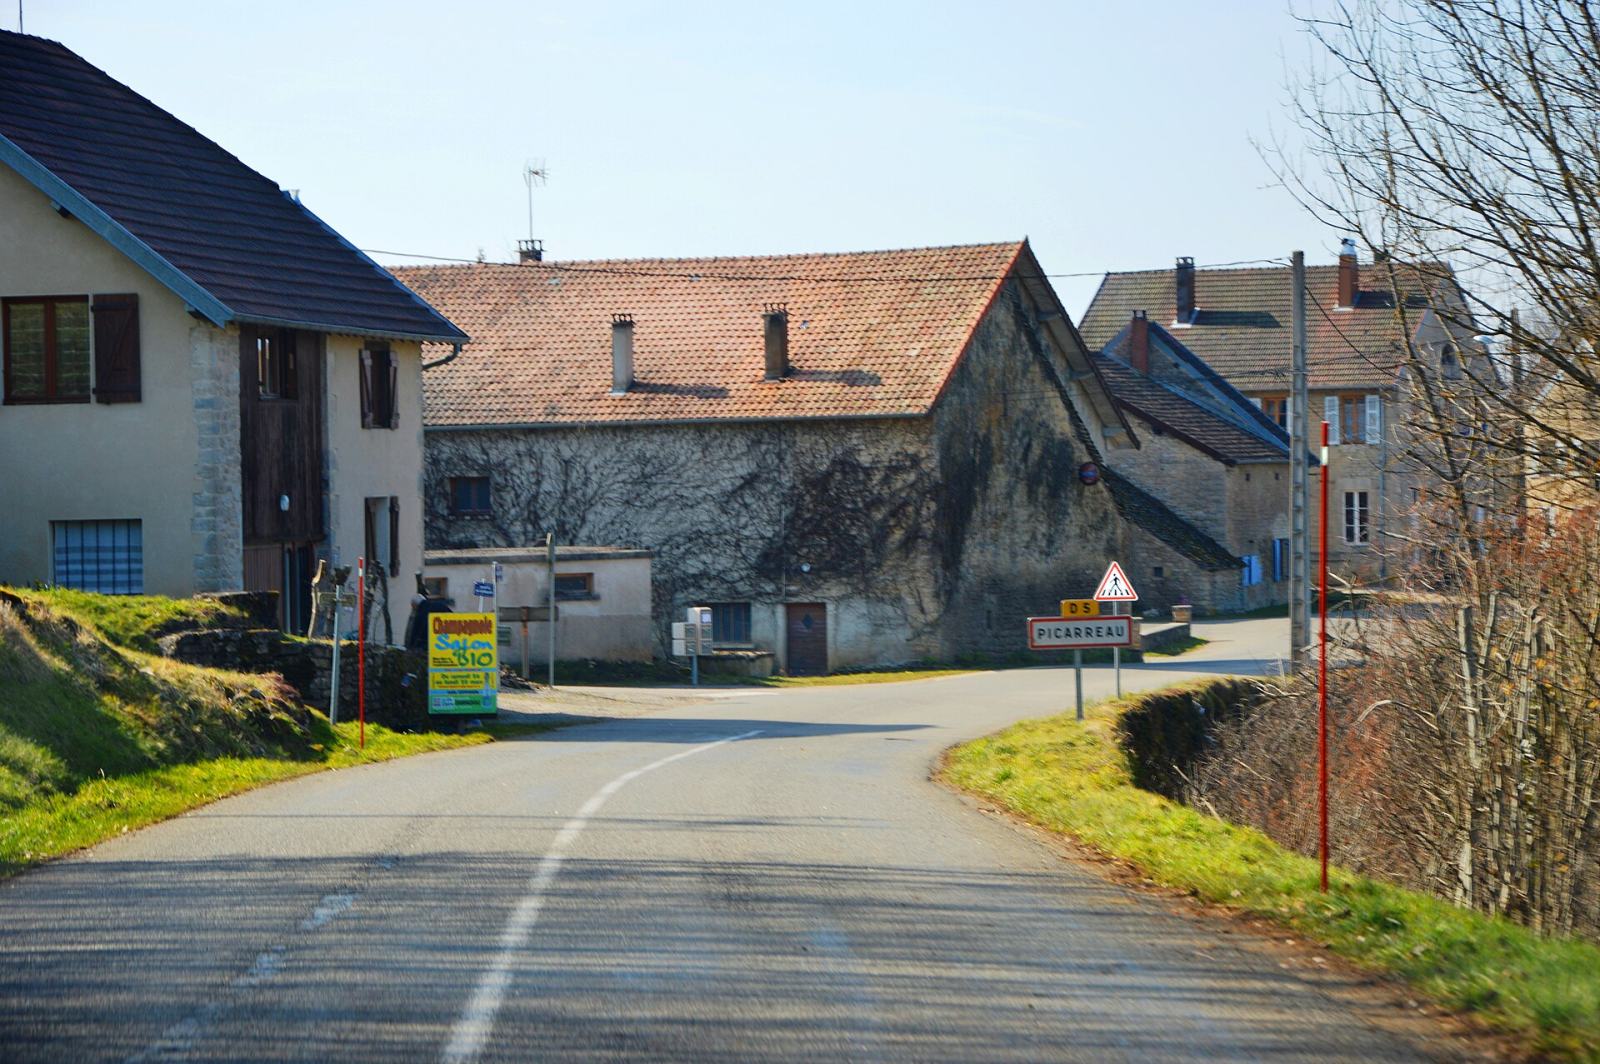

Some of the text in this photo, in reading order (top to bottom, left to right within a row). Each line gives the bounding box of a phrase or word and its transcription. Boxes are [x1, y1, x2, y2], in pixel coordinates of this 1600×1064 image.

[1069, 602, 1091, 614] D 5
[1037, 626, 1125, 640] PICARREAU
[434, 633, 493, 650] Salon
